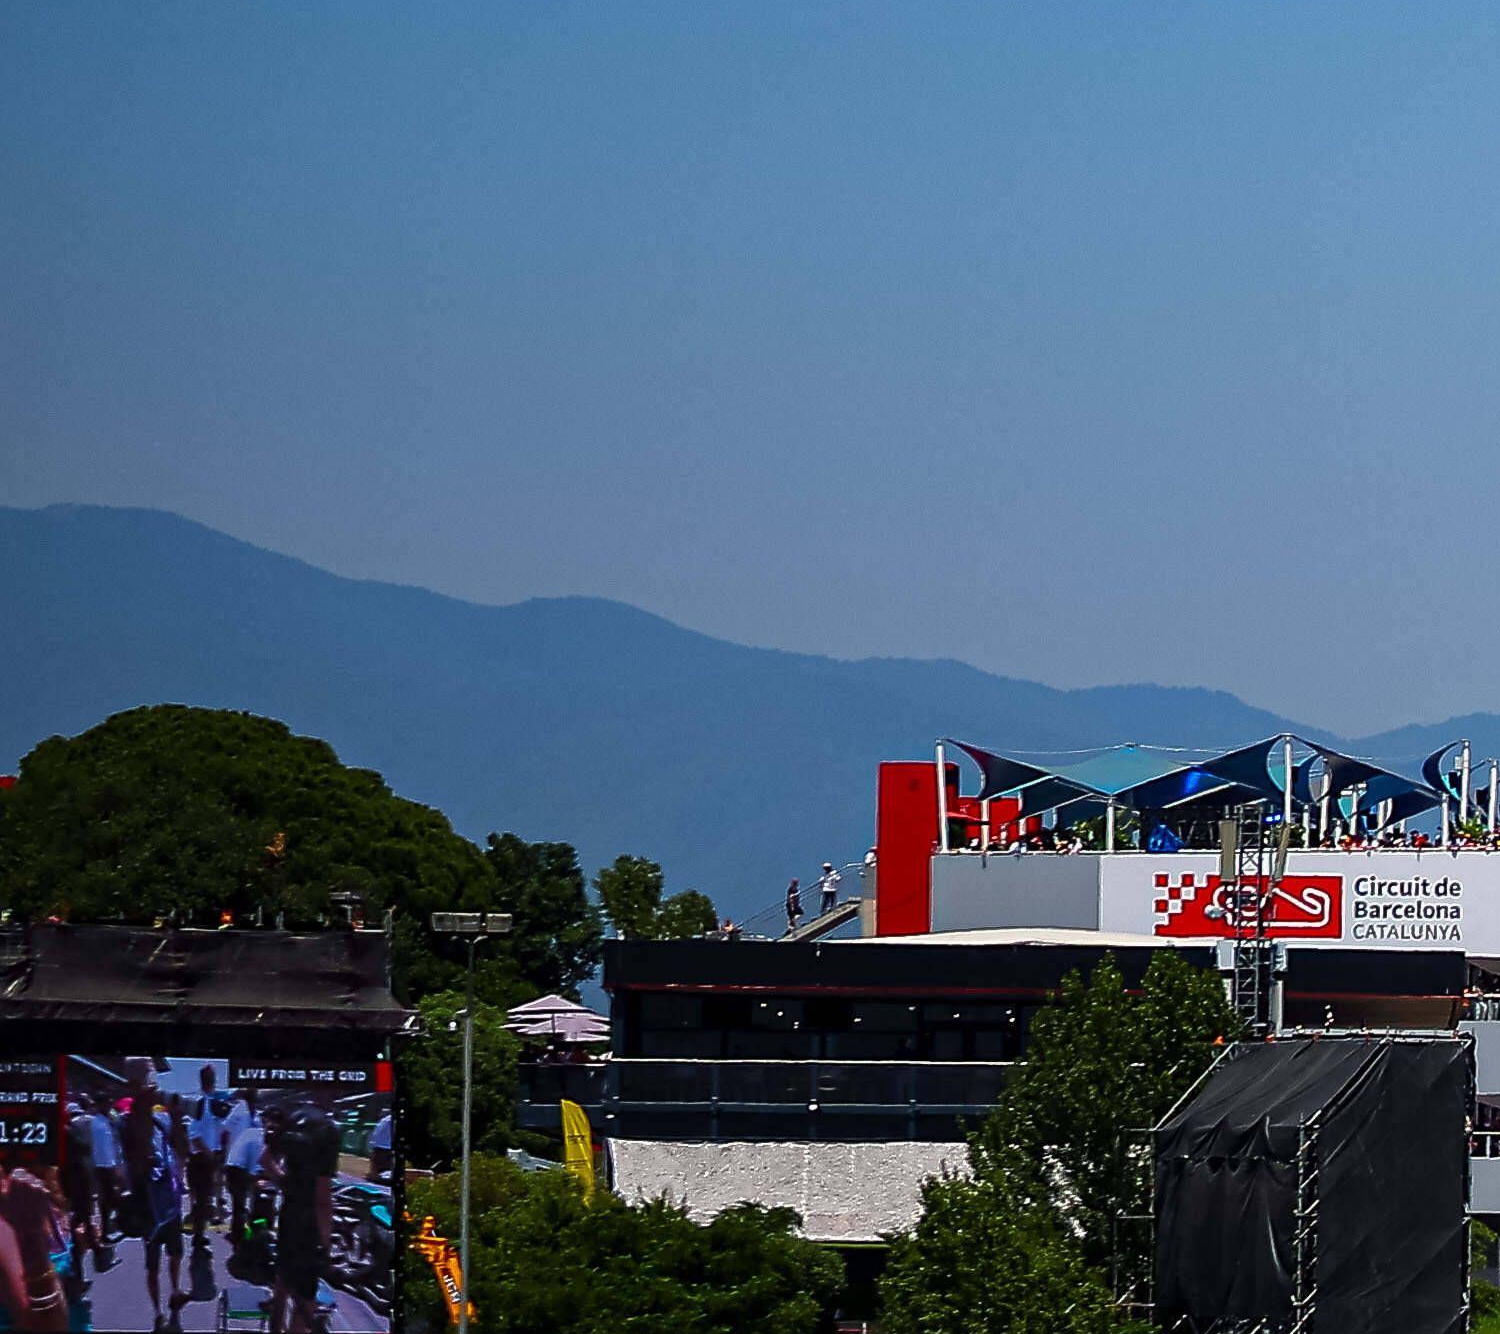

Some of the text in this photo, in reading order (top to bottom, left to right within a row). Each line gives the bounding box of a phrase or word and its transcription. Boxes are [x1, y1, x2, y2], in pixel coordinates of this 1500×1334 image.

[1354, 875, 1462, 897] Circuit de
[1354, 900, 1461, 919] Barcelona
[1352, 923, 1461, 941] CATALUNYA
